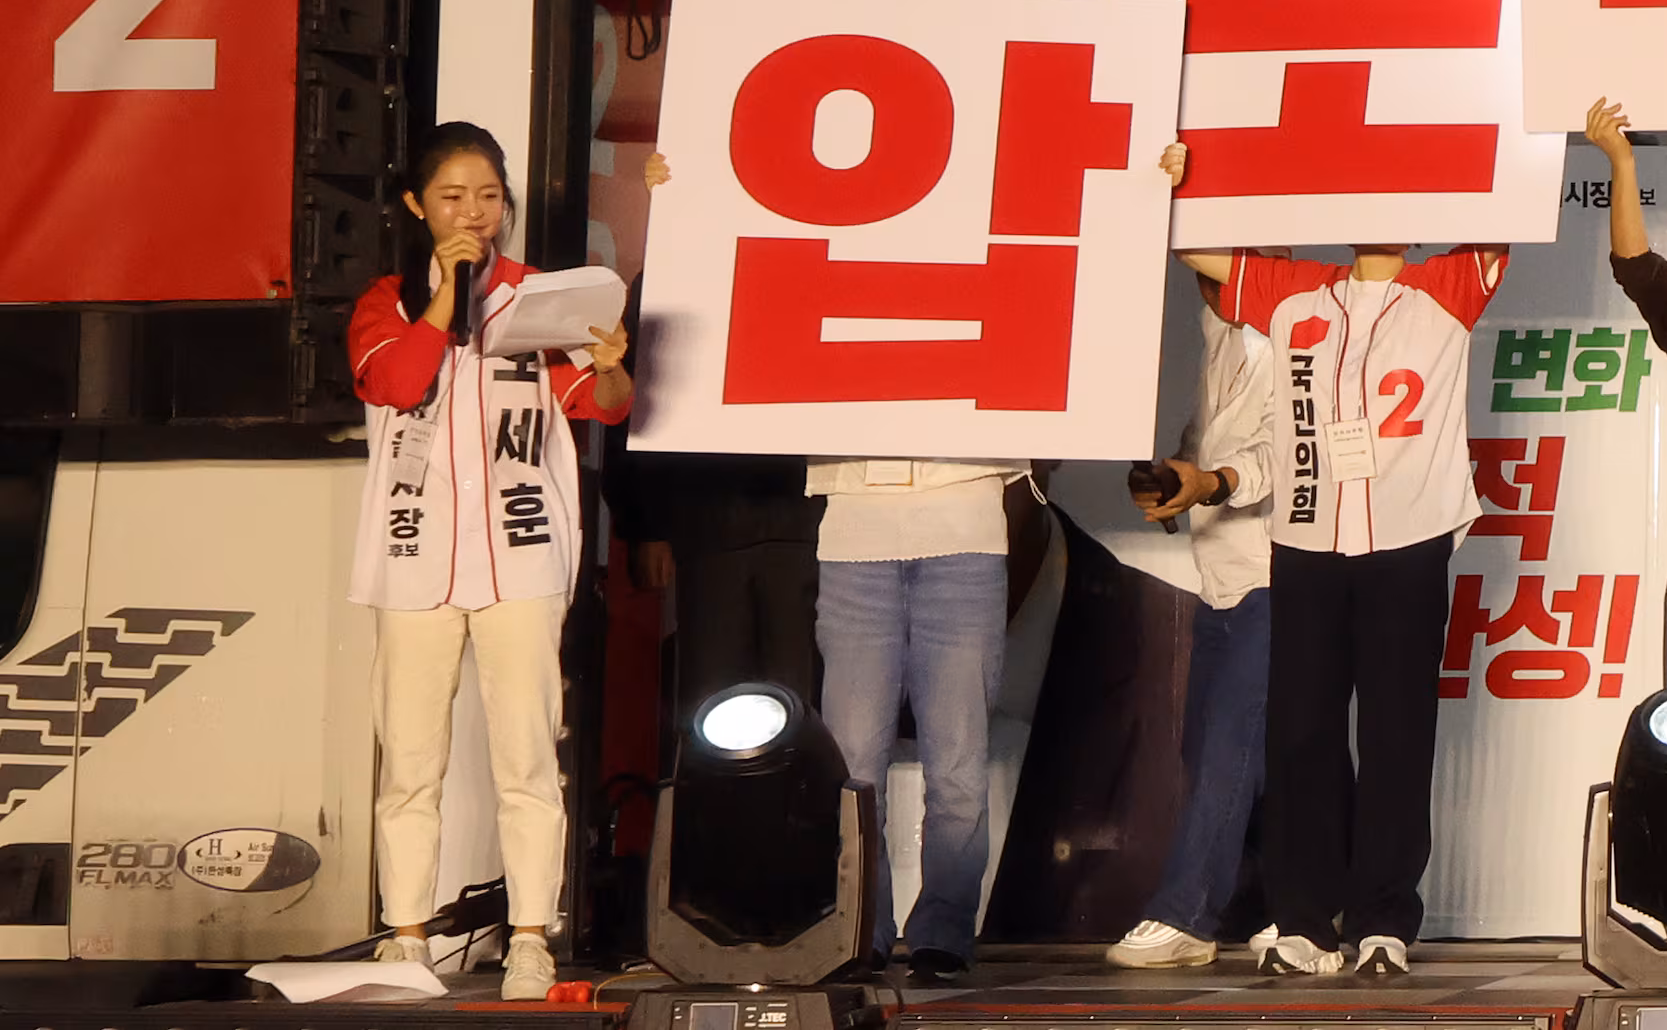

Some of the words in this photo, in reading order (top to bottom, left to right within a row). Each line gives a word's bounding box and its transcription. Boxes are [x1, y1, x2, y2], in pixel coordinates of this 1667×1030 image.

[722, 34, 1133, 412] 압
[1378, 368, 1424, 438] 2
[1491, 327, 1652, 412] 변화
[1289, 355, 1319, 524] 국민의힘
[77, 843, 177, 869] 280
